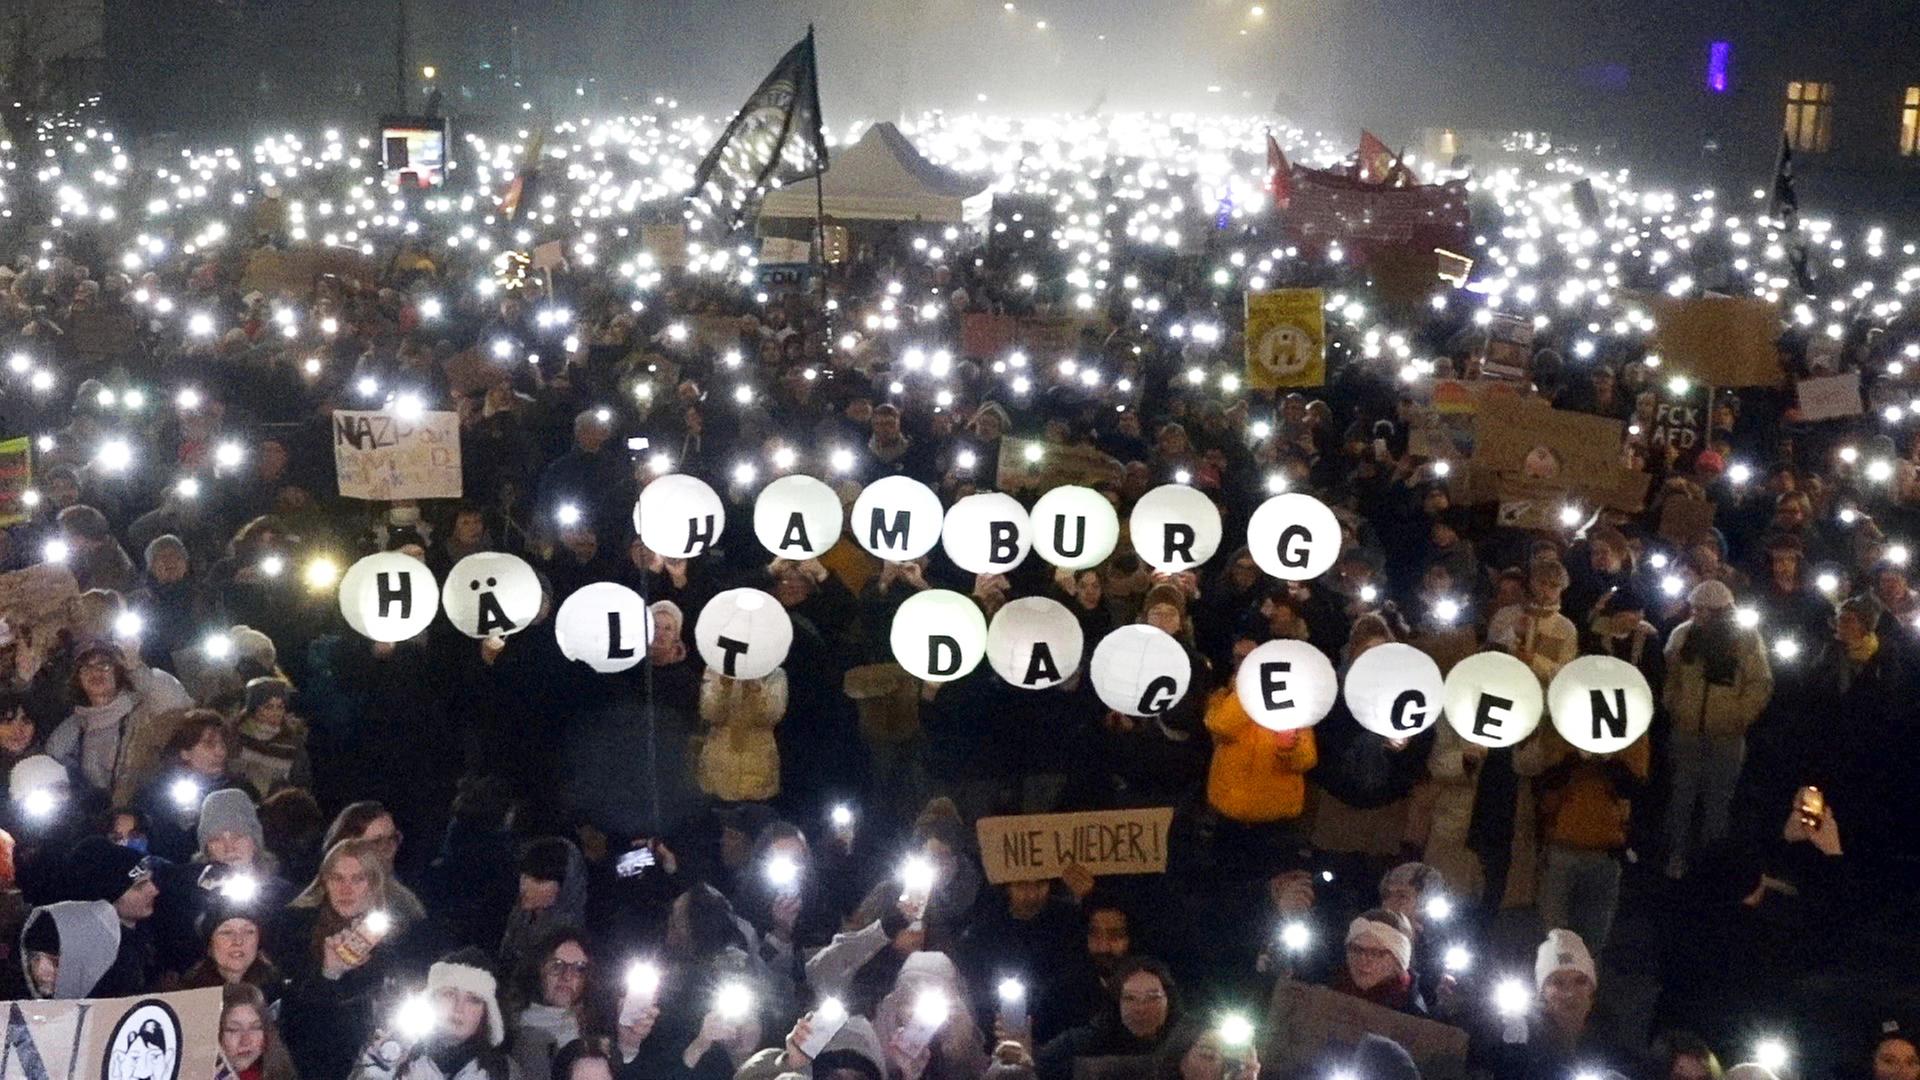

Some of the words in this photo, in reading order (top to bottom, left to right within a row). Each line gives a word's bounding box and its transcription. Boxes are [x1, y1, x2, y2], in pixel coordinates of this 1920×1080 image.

[1656, 403, 1699, 425] FCK
[684, 507, 1312, 568] HAMBURG
[377, 571, 749, 677] HÄLT
[928, 634, 1628, 741] DAGEGEN
[1003, 831, 1043, 867] NIE
